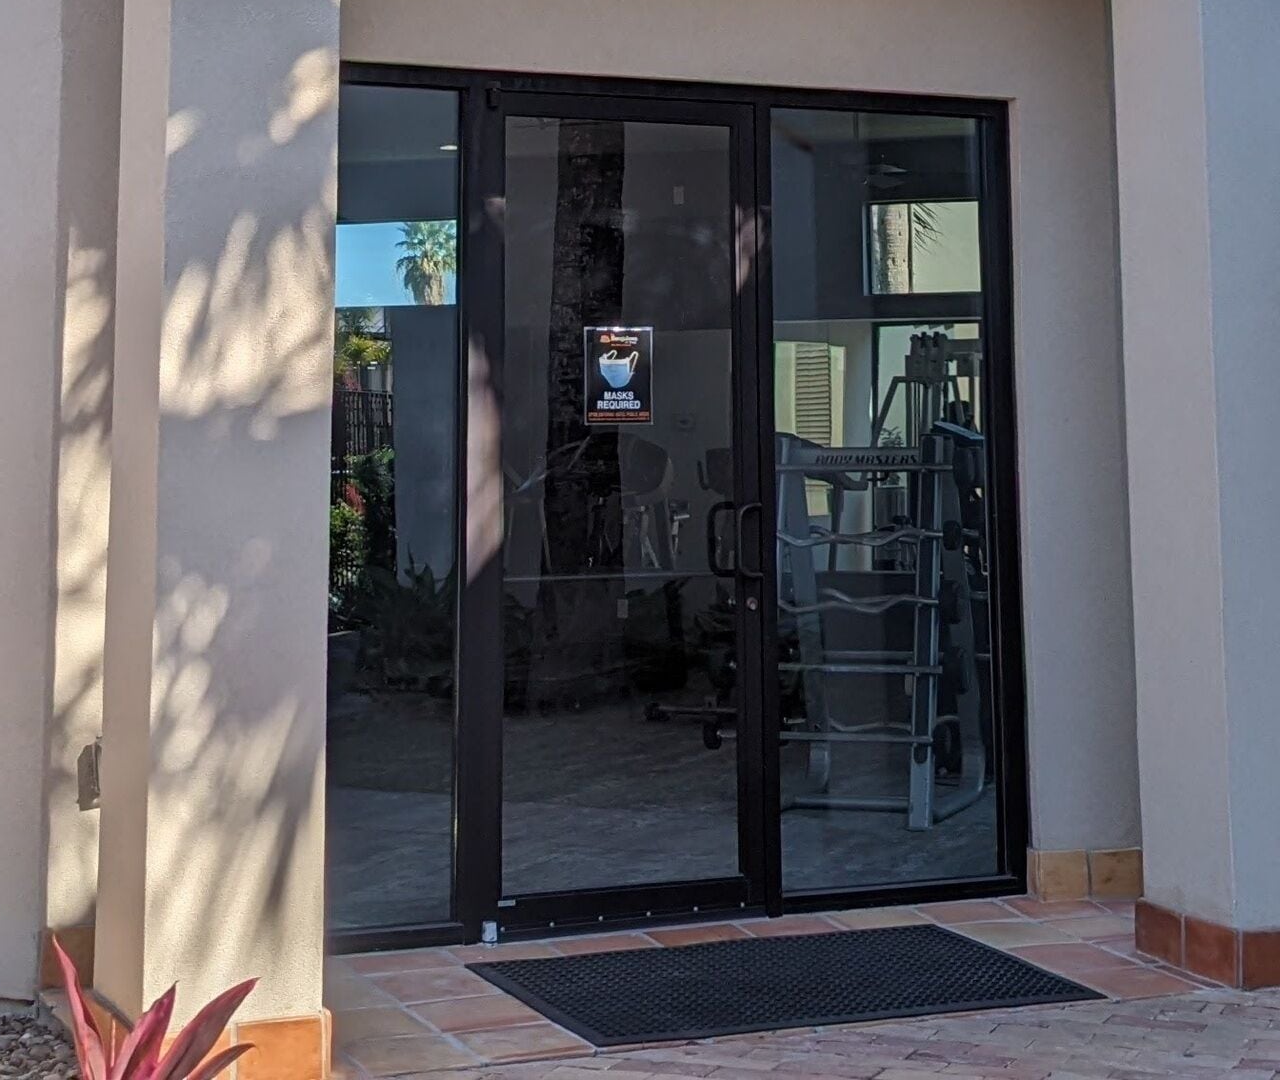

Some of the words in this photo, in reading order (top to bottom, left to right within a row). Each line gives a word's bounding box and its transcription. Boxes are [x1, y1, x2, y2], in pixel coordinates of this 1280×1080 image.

[603, 391, 634, 400] MASKS
[596, 400, 641, 410] REQUIRED
[855, 454, 919, 465] MASTERS
